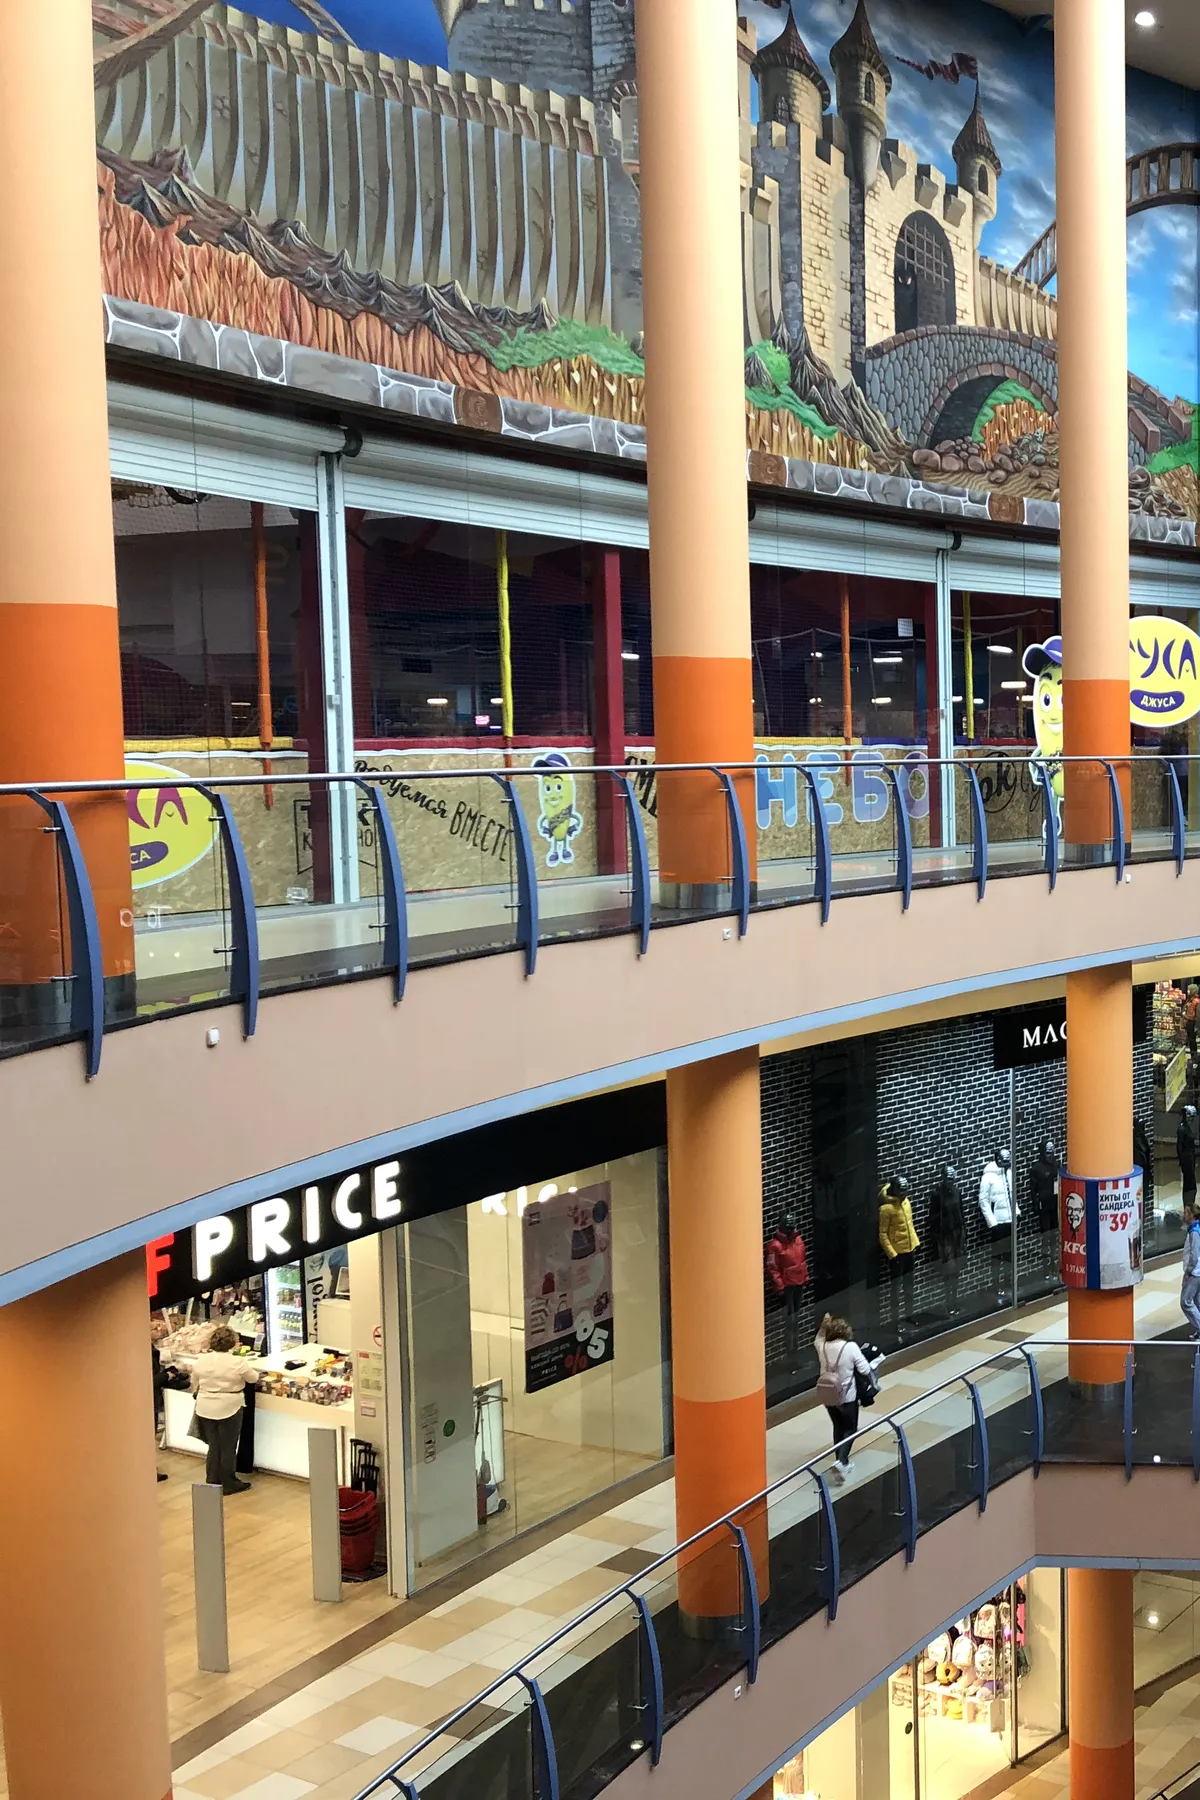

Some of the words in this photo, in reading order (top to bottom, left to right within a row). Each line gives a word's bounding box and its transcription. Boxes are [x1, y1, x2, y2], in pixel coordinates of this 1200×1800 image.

[1129, 637, 1197, 680] УСА
[1140, 694, 1177, 708] ДЖУСА
[755, 751, 930, 830] НЕБО
[450, 800, 517, 862] ВМЕСТЕ
[1100, 1193, 1121, 1203] ХИТЫ
[1122, 1192, 1131, 1200] ОТ
[1100, 1200, 1135, 1211] САНДЕРСА
[193, 1160, 401, 1282] PRICE
[1100, 1214, 1108, 1222] ОТ
